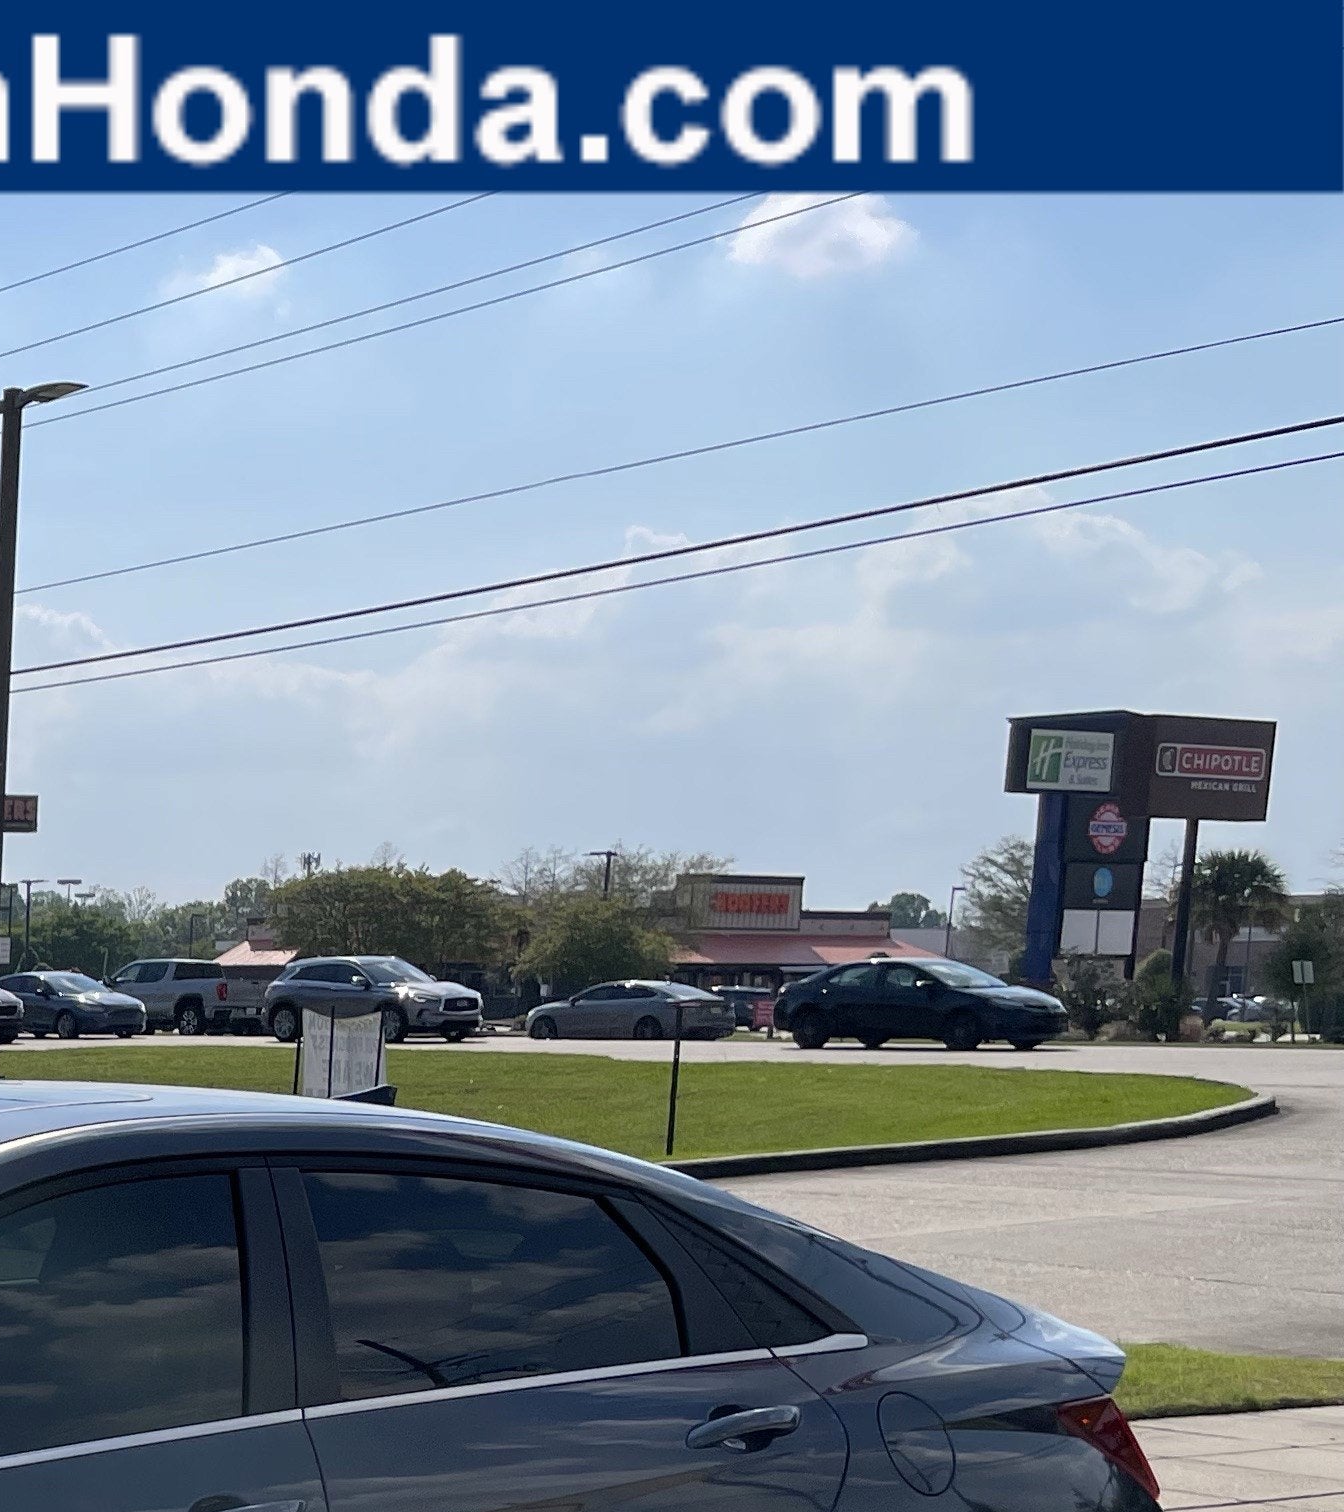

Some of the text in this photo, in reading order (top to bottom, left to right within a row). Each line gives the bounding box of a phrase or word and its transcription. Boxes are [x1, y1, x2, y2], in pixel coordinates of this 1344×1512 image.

[1064, 751, 1109, 772] Express
[1181, 753, 1261, 772] CHIPOTLE
[1191, 781, 1257, 793] MEXICAN GRILL
